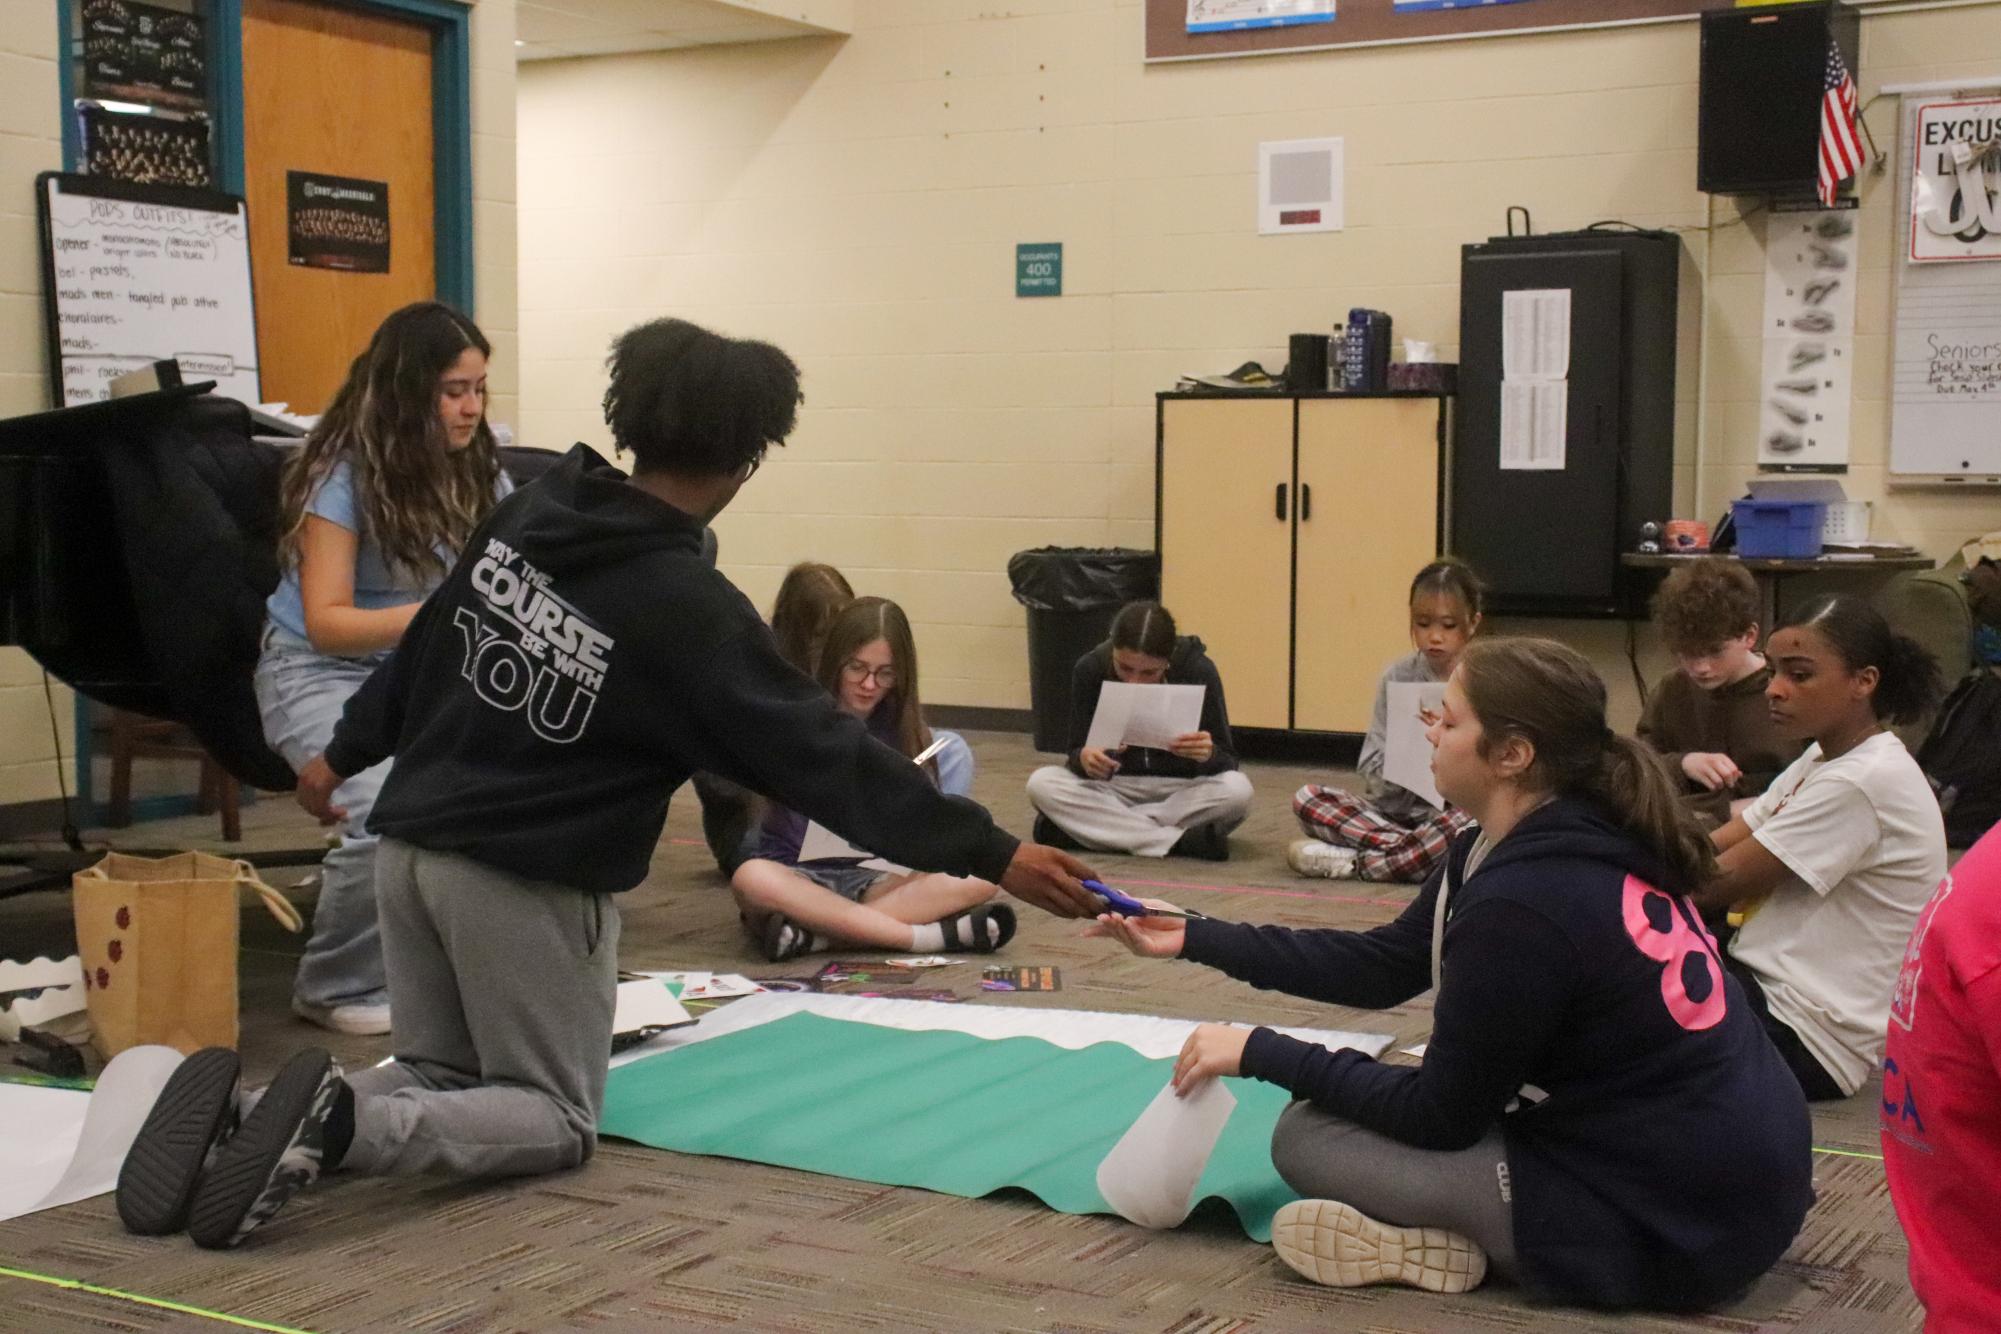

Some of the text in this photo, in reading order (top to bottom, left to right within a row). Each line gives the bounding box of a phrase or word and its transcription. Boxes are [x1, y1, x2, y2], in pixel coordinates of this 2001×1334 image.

[1026, 262, 1052, 276] 400
[520, 560, 555, 588] THE
[471, 556, 615, 674] COURSE
[453, 606, 597, 744] YOU
[519, 631, 605, 692] BE WITH
